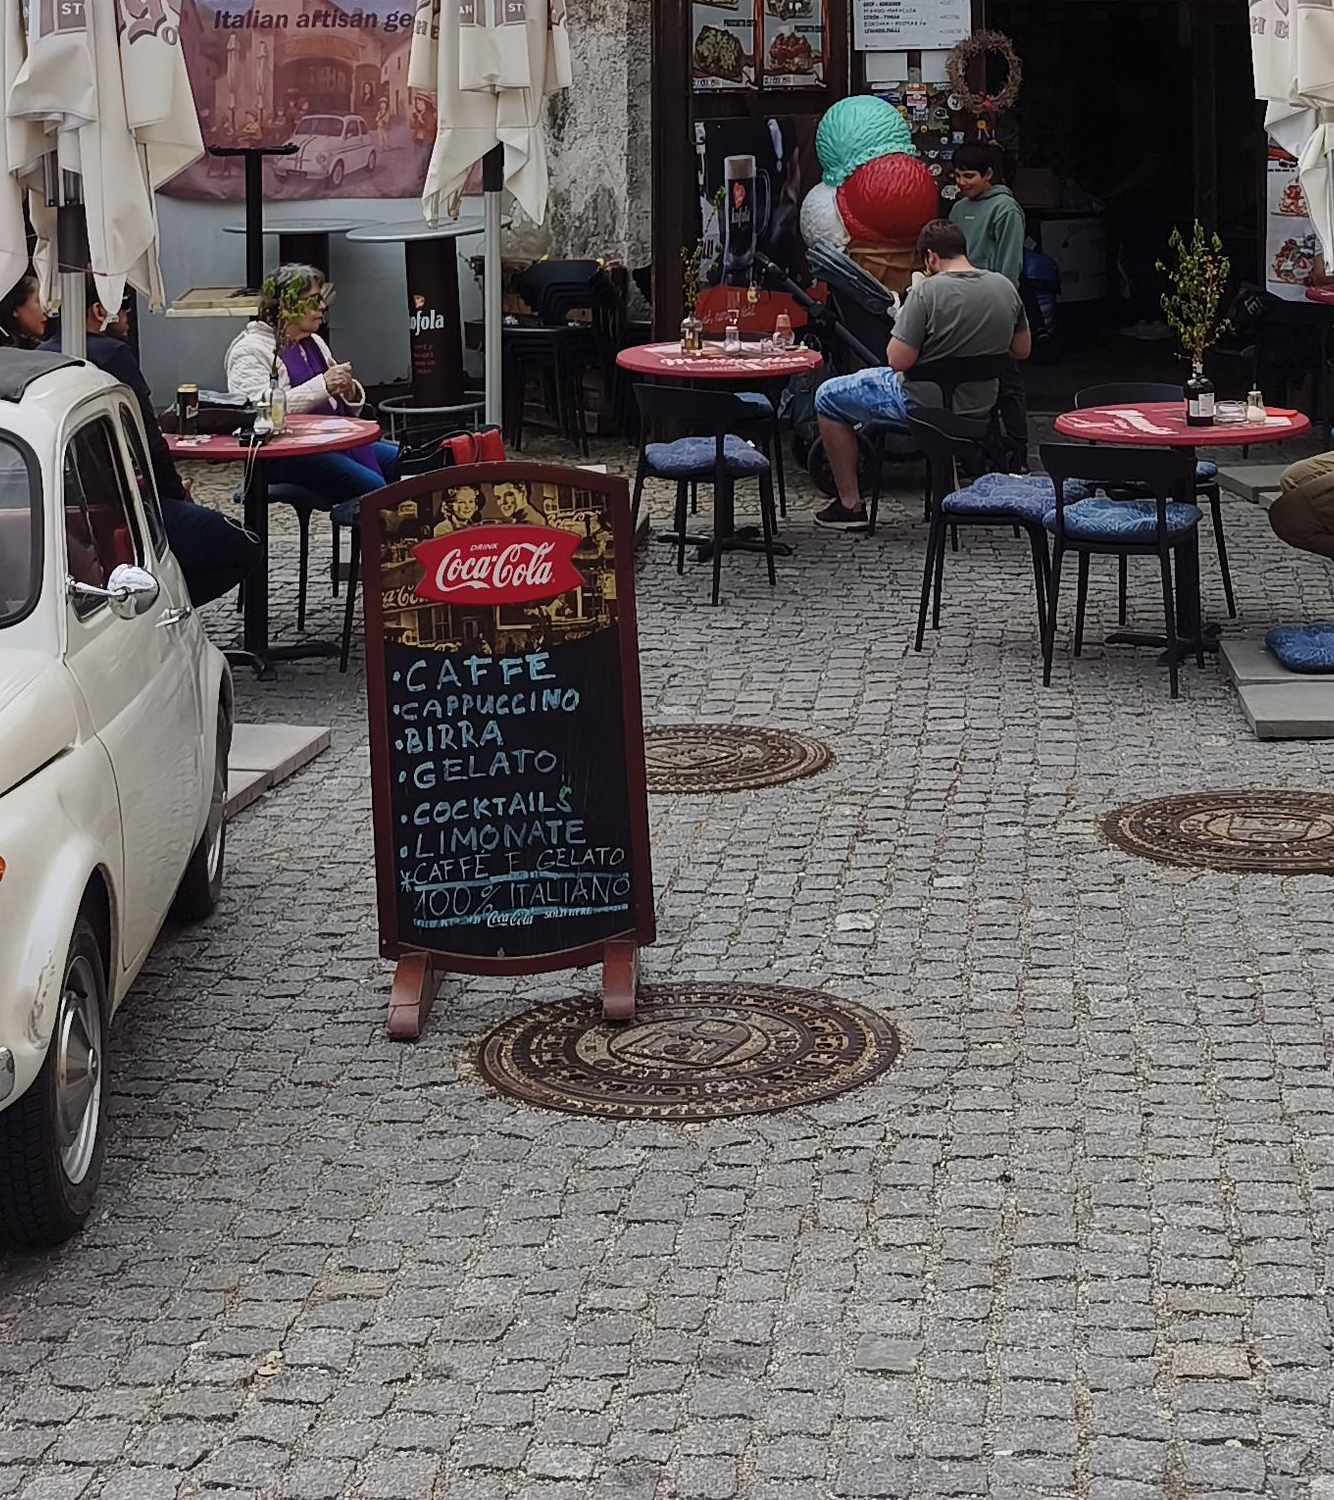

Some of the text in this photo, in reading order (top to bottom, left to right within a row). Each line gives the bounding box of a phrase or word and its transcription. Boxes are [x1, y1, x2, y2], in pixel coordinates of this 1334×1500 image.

[214, 10, 288, 29] Italian
[296, 9, 378, 29] artisan
[410, 309, 444, 336] ofola
[470, 542, 499, 552] DRINK
[435, 541, 556, 592] Coca-Cola
[402, 688, 580, 721] CAPPUCCINO
[404, 719, 504, 754] BIRRA
[413, 748, 557, 789] GELATO
[413, 785, 572, 826] COCKTAILS
[415, 819, 586, 858] LIMONATE
[536, 847, 625, 871] GELATO
[510, 874, 631, 908] ITALIANO
